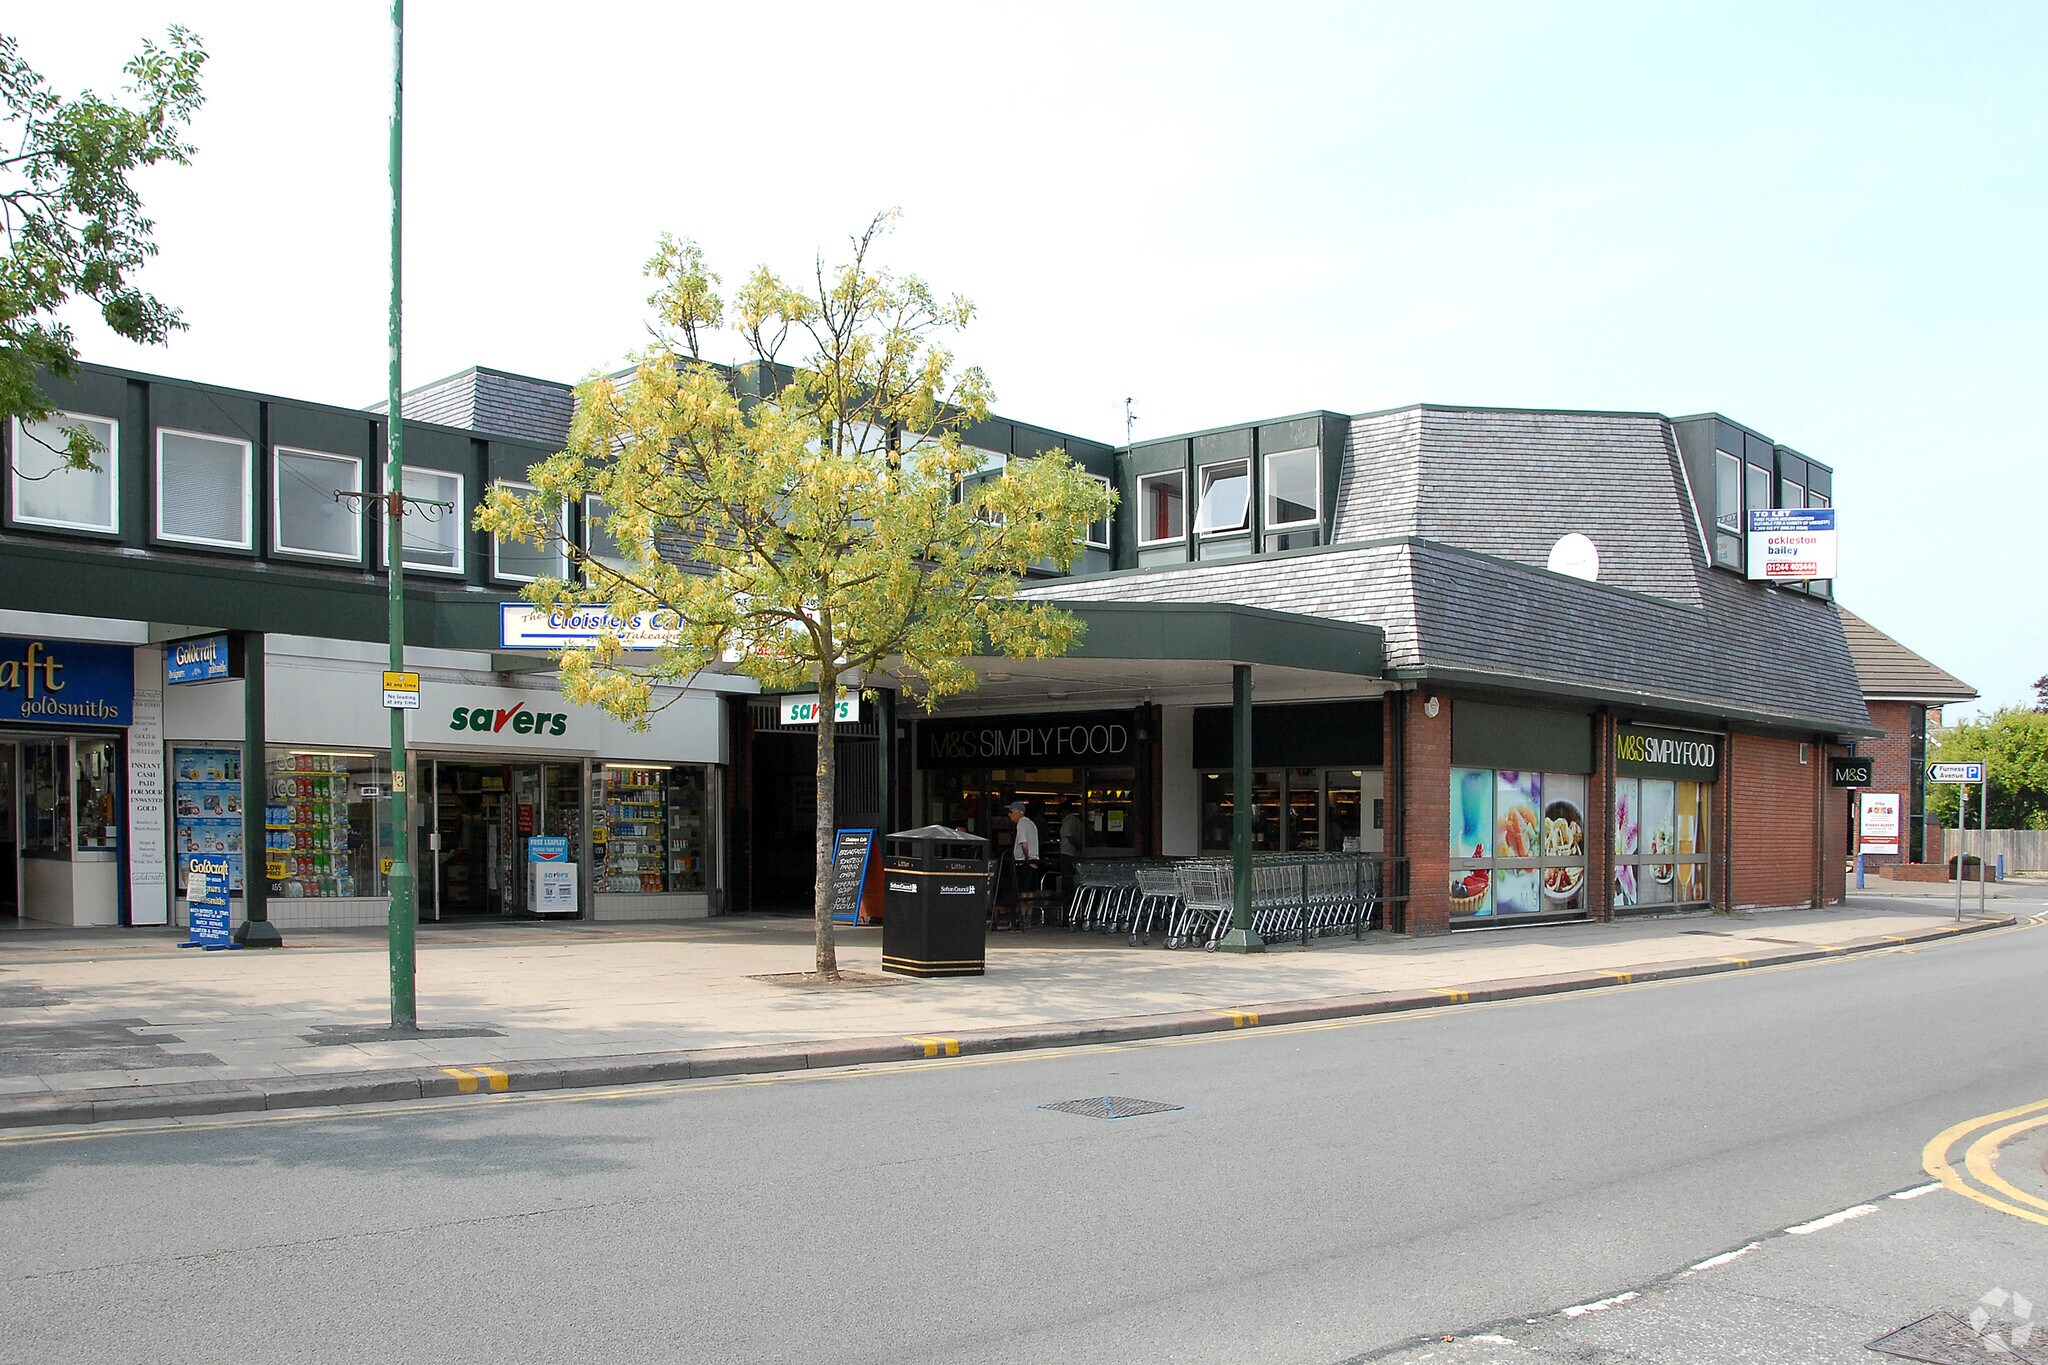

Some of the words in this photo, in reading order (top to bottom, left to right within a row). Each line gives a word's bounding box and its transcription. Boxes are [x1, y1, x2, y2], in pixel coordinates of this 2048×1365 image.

[1768, 536, 1817, 545] ockleston
[1768, 546, 1798, 555] bailey
[1767, 563, 1789, 571] 01244
[521, 611, 543, 623] The
[625, 630, 681, 640] Takeawa
[176, 638, 217, 666] Goldcraft
[21, 696, 118, 719] goldsmiths
[790, 702, 849, 721] savrs
[449, 701, 568, 736] savers
[930, 730, 976, 758] M&S
[979, 728, 1054, 757] SIMPLY
[1057, 725, 1128, 755] FOOD
[1617, 734, 1645, 762] M&S
[1645, 737, 1683, 765] SIMPLY
[1683, 741, 1715, 767] FOOD
[1835, 767, 1867, 782] M&S
[190, 859, 229, 881] Goldcraft
